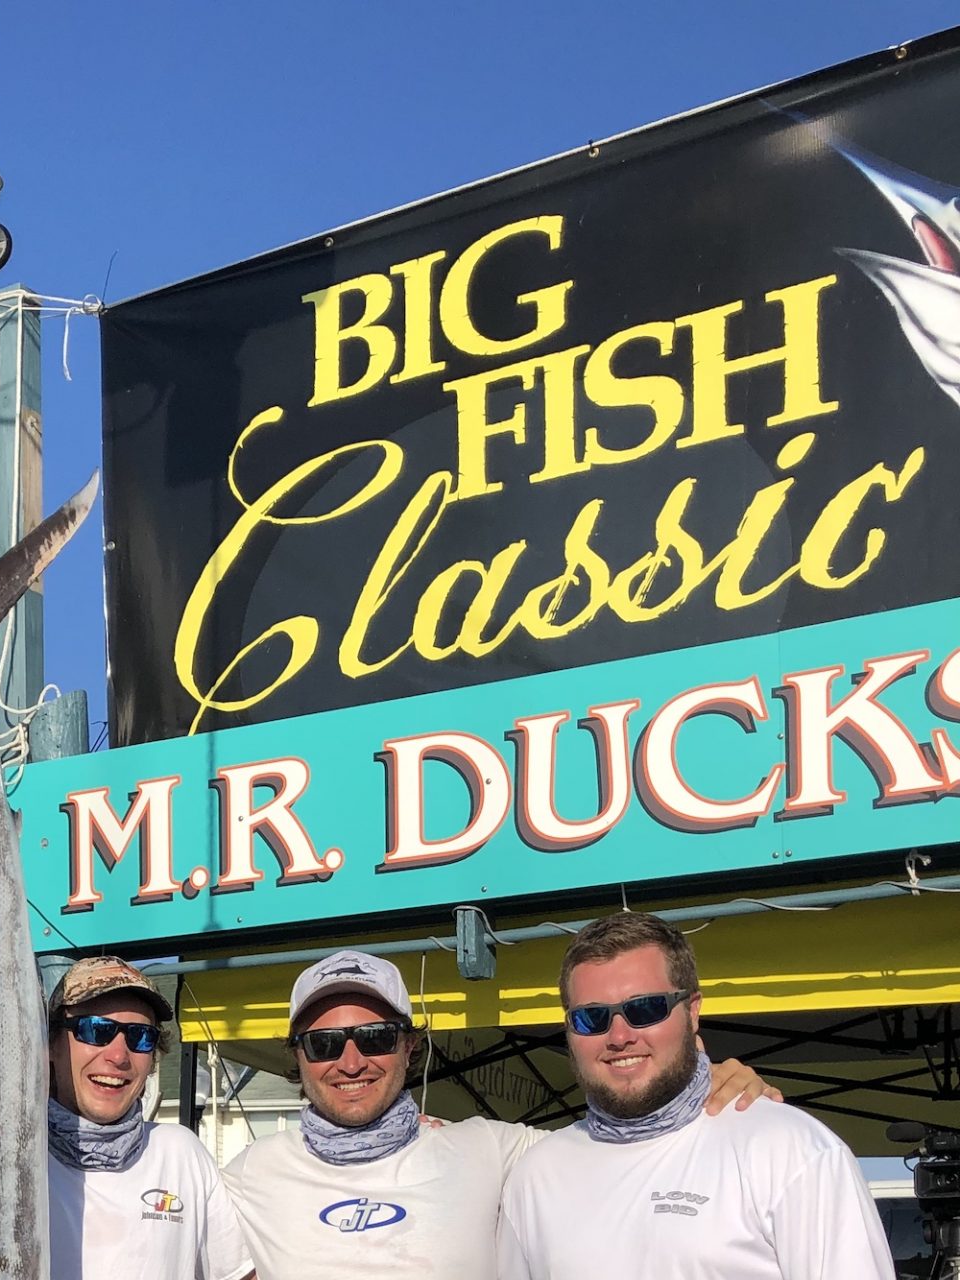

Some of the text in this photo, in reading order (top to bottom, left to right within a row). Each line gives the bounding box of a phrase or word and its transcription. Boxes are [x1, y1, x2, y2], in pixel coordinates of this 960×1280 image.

[302, 215, 574, 408] BIG
[443, 274, 839, 502] FISH
[174, 405, 926, 735] Classic
[63, 754, 347, 914] M.R.
[650, 1191, 710, 1205] LOW
[654, 1204, 698, 1216] BID
